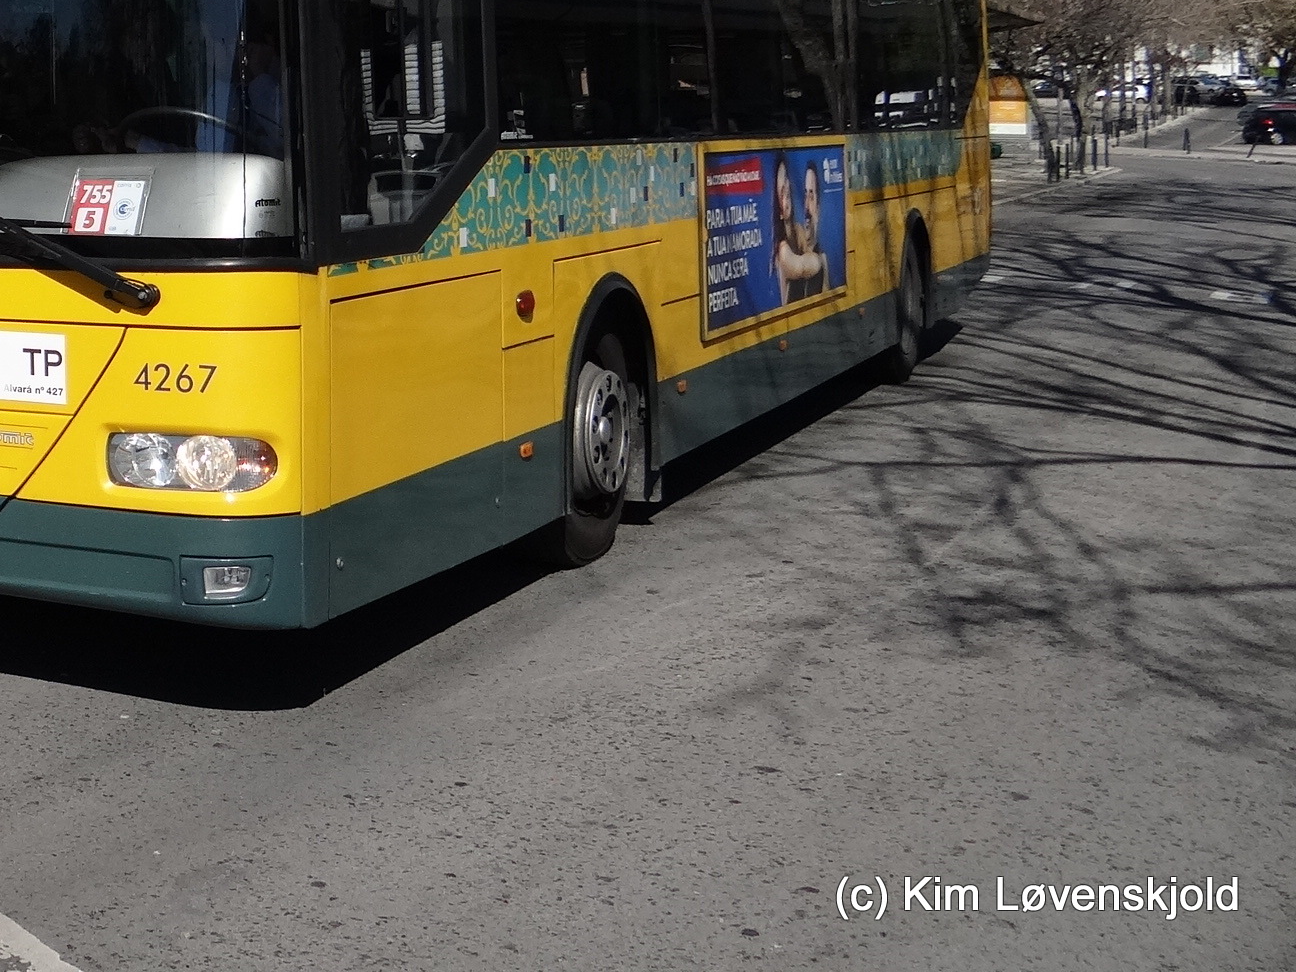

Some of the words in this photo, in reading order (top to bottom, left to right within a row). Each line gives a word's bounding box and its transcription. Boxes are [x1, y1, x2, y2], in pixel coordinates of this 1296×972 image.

[80, 185, 113, 204] 755
[83, 210, 97, 229] 5
[707, 208, 725, 229] PARA
[22, 348, 63, 377] TP
[133, 362, 218, 393] 4267
[4, 384, 32, 394] Alvará
[46, 387, 64, 397] 427
